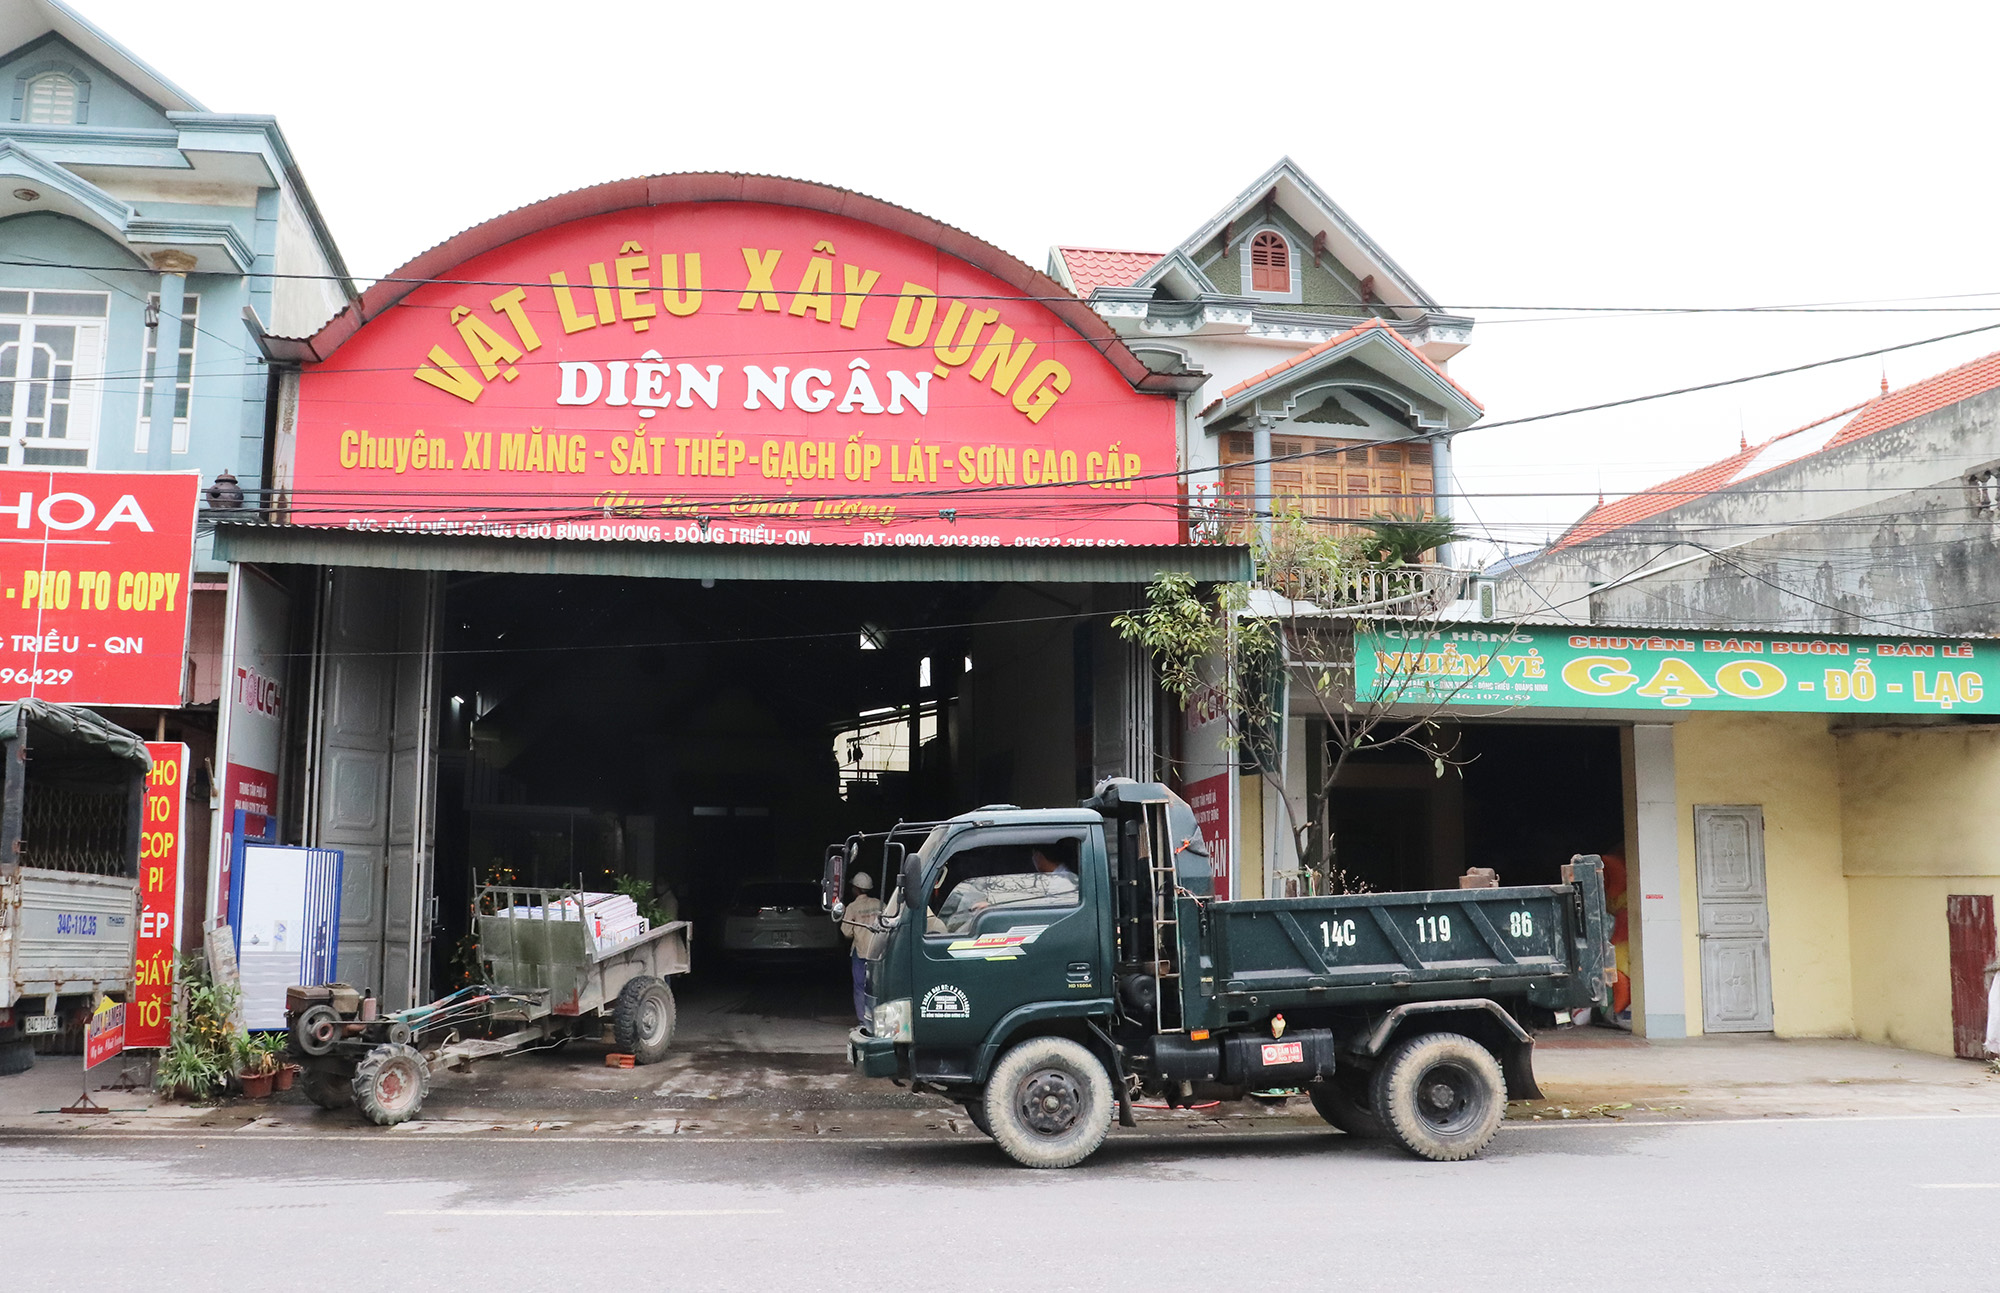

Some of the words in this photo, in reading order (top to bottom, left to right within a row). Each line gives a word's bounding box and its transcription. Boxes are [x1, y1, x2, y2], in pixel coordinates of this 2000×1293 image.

[413, 305, 542, 403] VẬT
[549, 240, 702, 334] LIỆU
[737, 240, 881, 329] XÂY
[887, 281, 1072, 424] DỰNG
[556, 349, 723, 418] DIỆN
[742, 357, 933, 416] NGÂN
[461, 432, 492, 470] XI
[499, 426, 586, 473] MĂNG
[610, 423, 666, 474] SẮT
[844, 431, 882, 481] ỐP
[1022, 449, 1078, 488] CAO
[1086, 441, 1141, 490] CẤP
[22, 570, 71, 609] PHO
[78, 571, 111, 610] TO
[117, 571, 180, 611] COPY
[11, 629, 79, 653] TRIỀU
[104, 636, 143, 654] QN
[1567, 635, 1695, 652] CHUYÊN:
[1703, 637, 1764, 654] BÁN
[1771, 638, 1851, 656] BUÔN
[1876, 641, 1936, 658] BÁN
[1942, 641, 1974, 659] LẺ
[1497, 648, 1546, 679] VẺ
[1561, 656, 1788, 706] GẠO
[1823, 658, 1877, 702] ĐỖ
[1912, 670, 1983, 708] LẠC
[145, 760, 177, 785] HO
[149, 796, 170, 822] TO
[141, 832, 174, 858] COP
[148, 867, 163, 892] PI
[140, 905, 169, 938] ÉP
[1320, 919, 1356, 947] 14C
[1416, 915, 1451, 943] 119
[1510, 911, 1533, 938] 86
[136, 950, 172, 986] GIẤY
[138, 993, 161, 1027] TỜ
